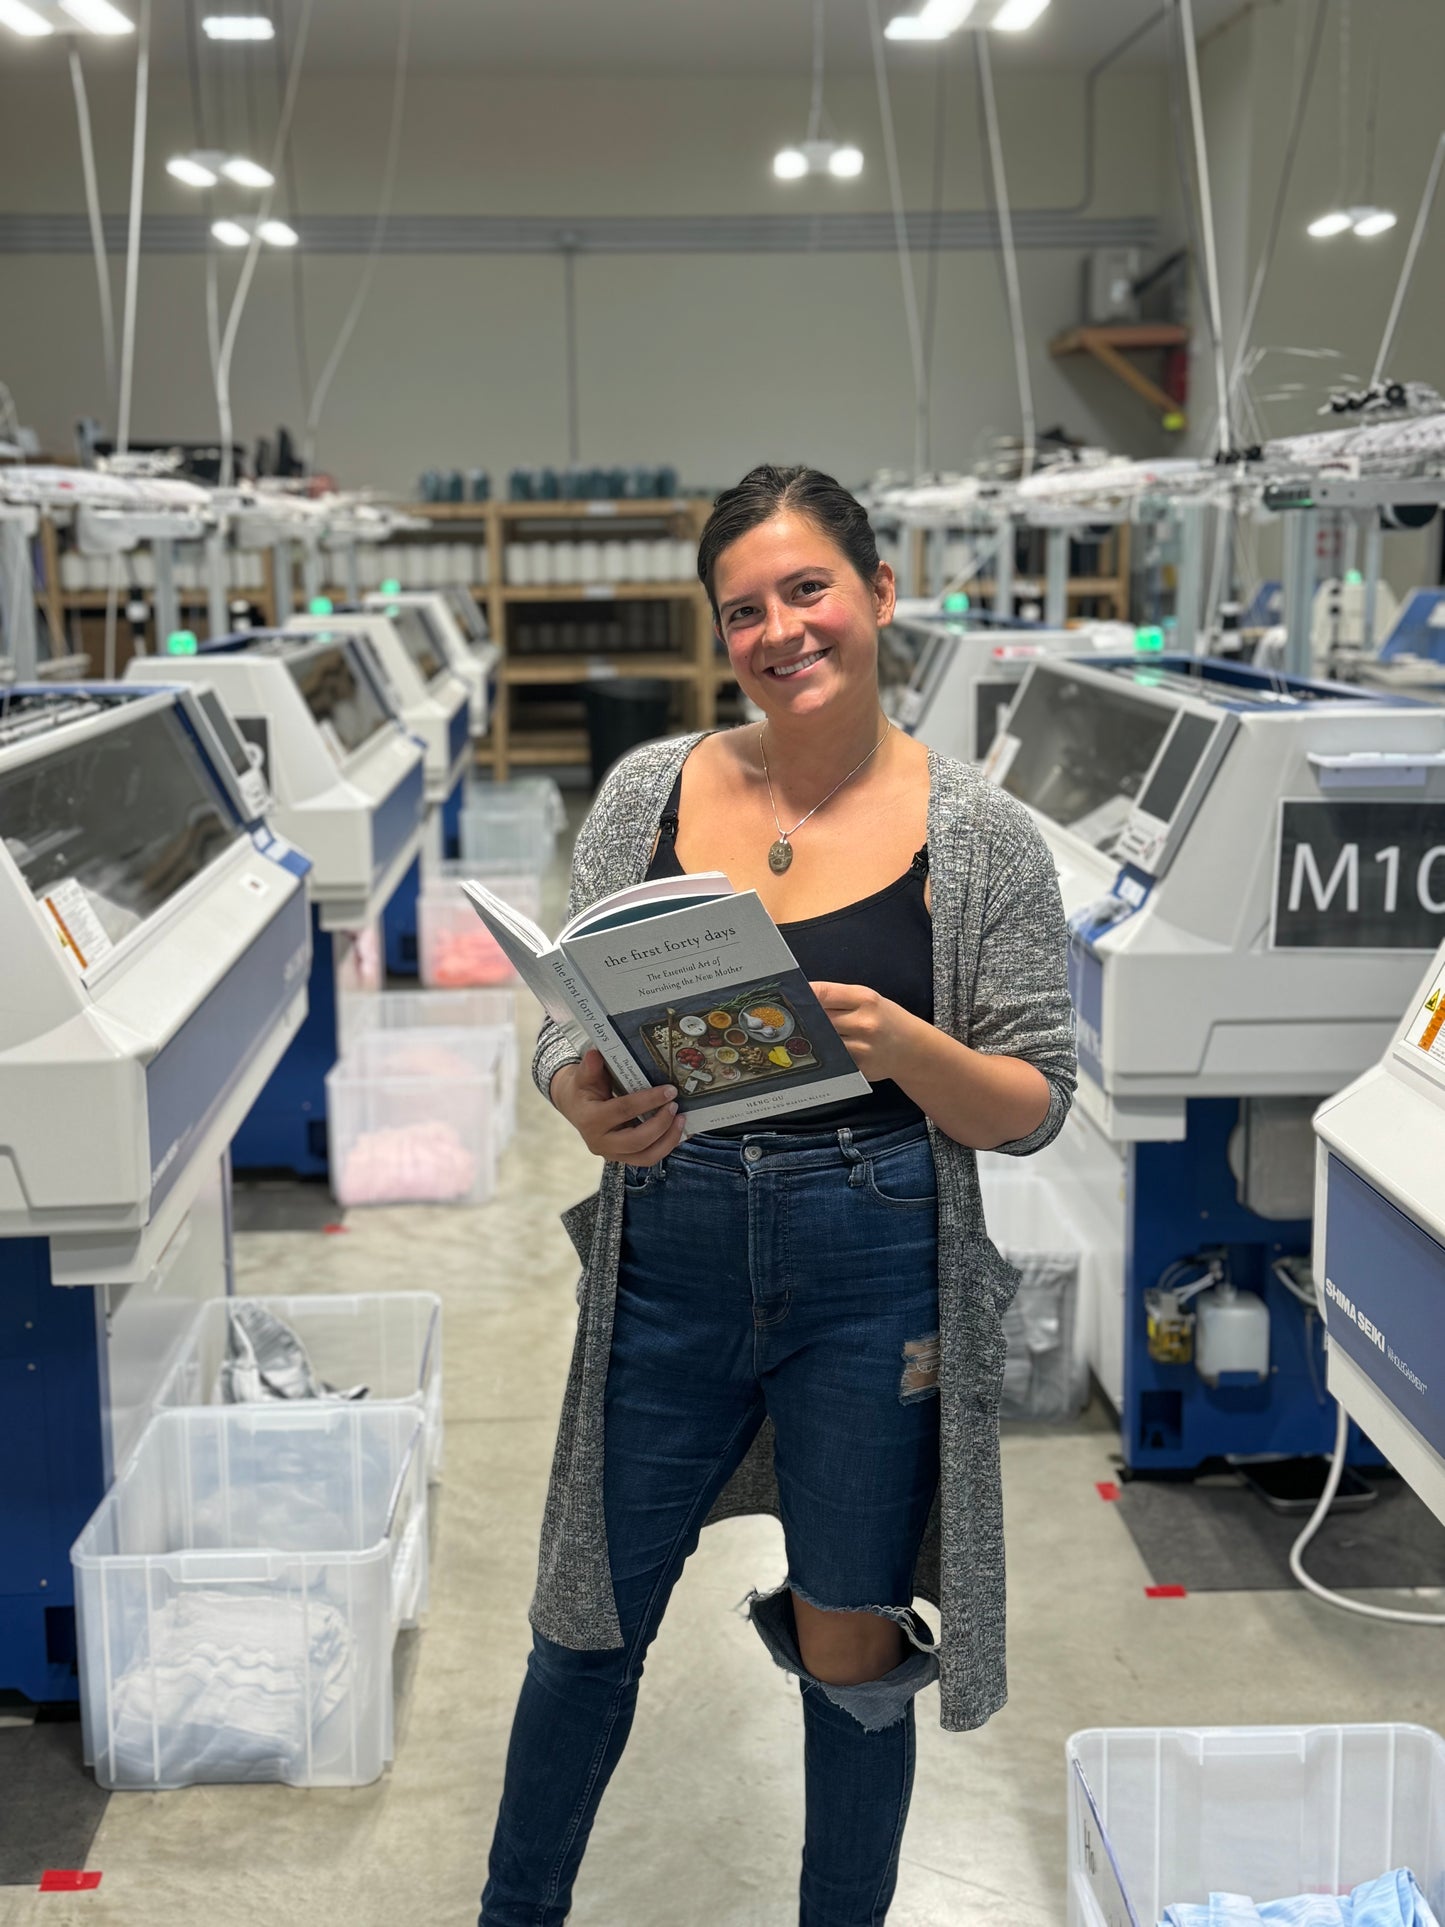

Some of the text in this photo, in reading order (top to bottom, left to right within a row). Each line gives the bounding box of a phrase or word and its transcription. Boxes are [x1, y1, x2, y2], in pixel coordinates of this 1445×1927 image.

[604, 927, 737, 968] the first forty days
[638, 964, 744, 997] Nourishing the New Mother
[646, 956, 721, 982] The Essential Art of
[552, 961, 609, 1042] the first forty days
[1325, 1277, 1357, 1324] SHIMA
[1357, 1310, 1386, 1353] SEIKI
